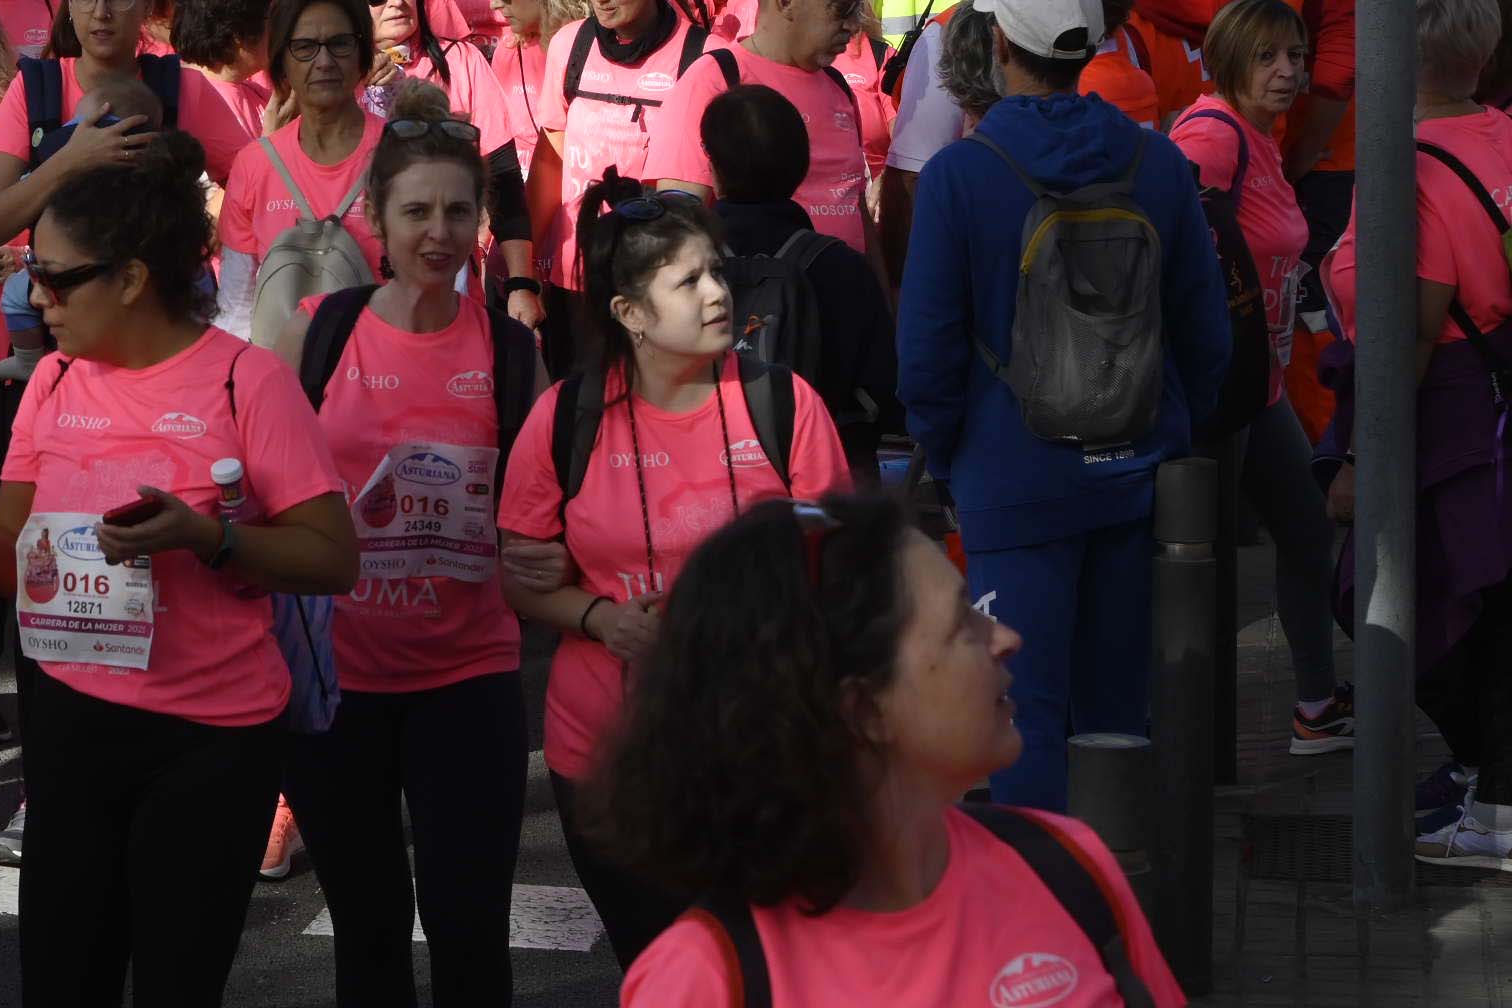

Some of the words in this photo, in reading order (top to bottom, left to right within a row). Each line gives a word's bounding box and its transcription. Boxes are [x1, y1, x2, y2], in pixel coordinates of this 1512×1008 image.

[57, 413, 112, 430] OYSHO
[401, 465, 456, 480] ASTURIANA
[400, 495, 449, 515] 016
[404, 520, 442, 533] 24349
[363, 559, 406, 570] OYSHO
[438, 557, 485, 572] Santander
[63, 572, 110, 595] 016
[67, 600, 103, 615] 12871
[30, 617, 66, 628] CARRERA
[68, 620, 80, 629] DE
[81, 622, 93, 630] LA
[95, 622, 124, 632] MUJER
[28, 636, 68, 652] OYSHO
